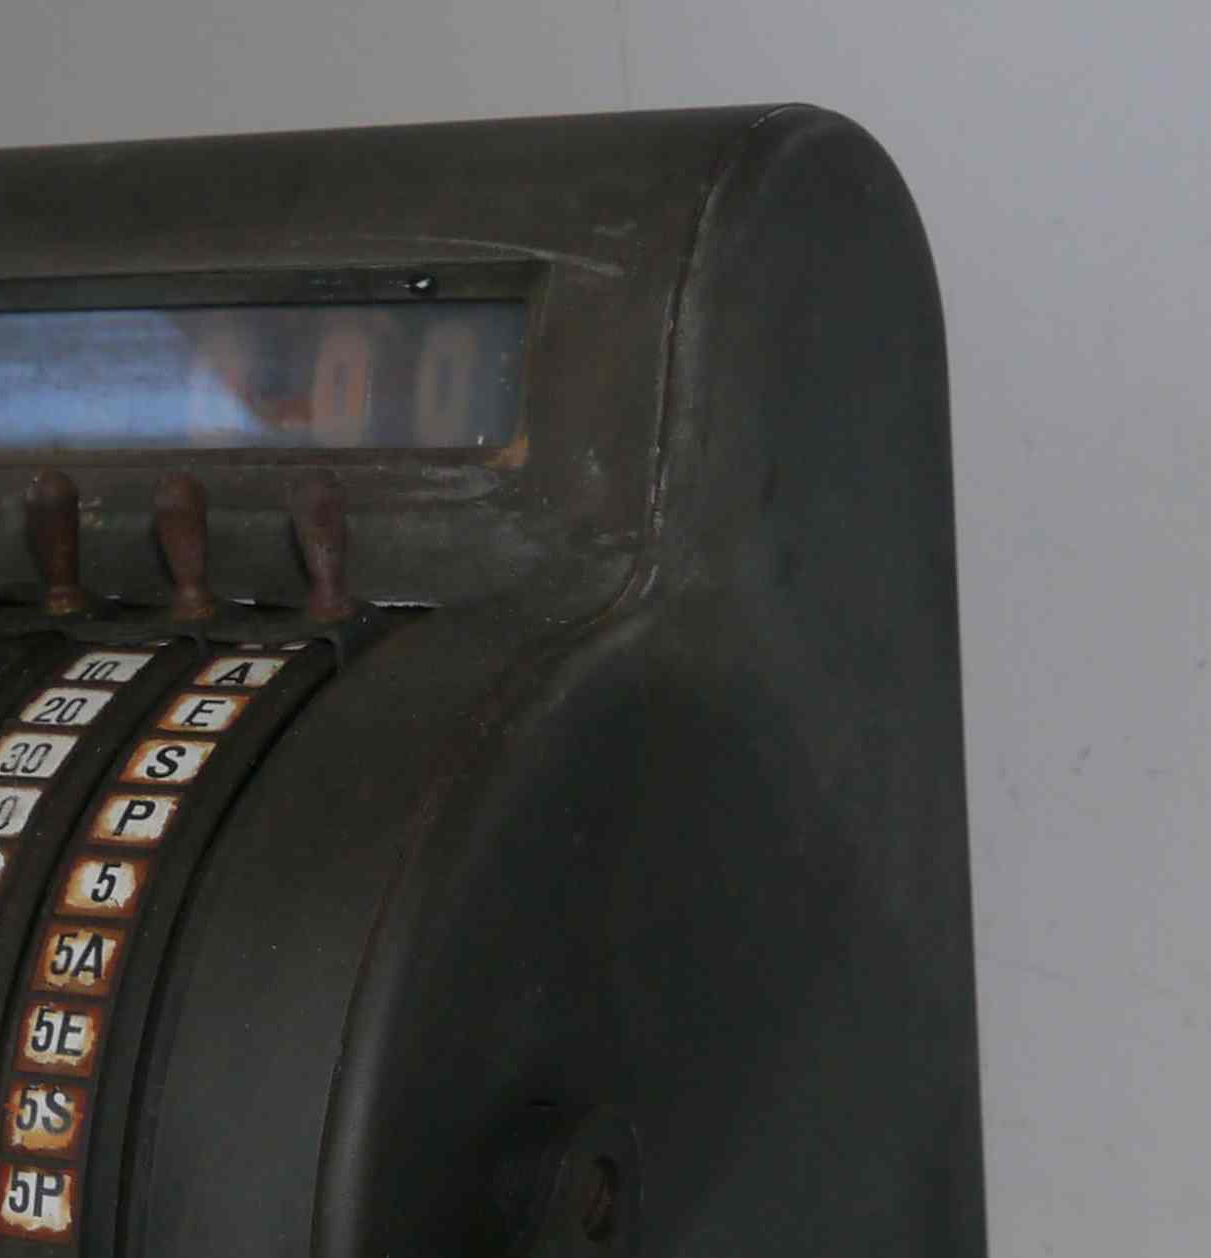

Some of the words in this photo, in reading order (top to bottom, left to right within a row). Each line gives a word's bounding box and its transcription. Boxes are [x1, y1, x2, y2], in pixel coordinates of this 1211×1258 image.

[81, 659, 120, 681] 10
[216, 661, 251, 686] A
[35, 696, 88, 724] 20
[186, 699, 226, 727] E
[0, 742, 54, 774] 30
[146, 745, 187, 778] S
[112, 798, 157, 836] P
[90, 863, 123, 902] 5
[50, 931, 105, 979] 5A
[31, 1007, 85, 1057] 5E
[15, 1083, 73, 1136] 5S
[8, 1170, 65, 1219] 5P
